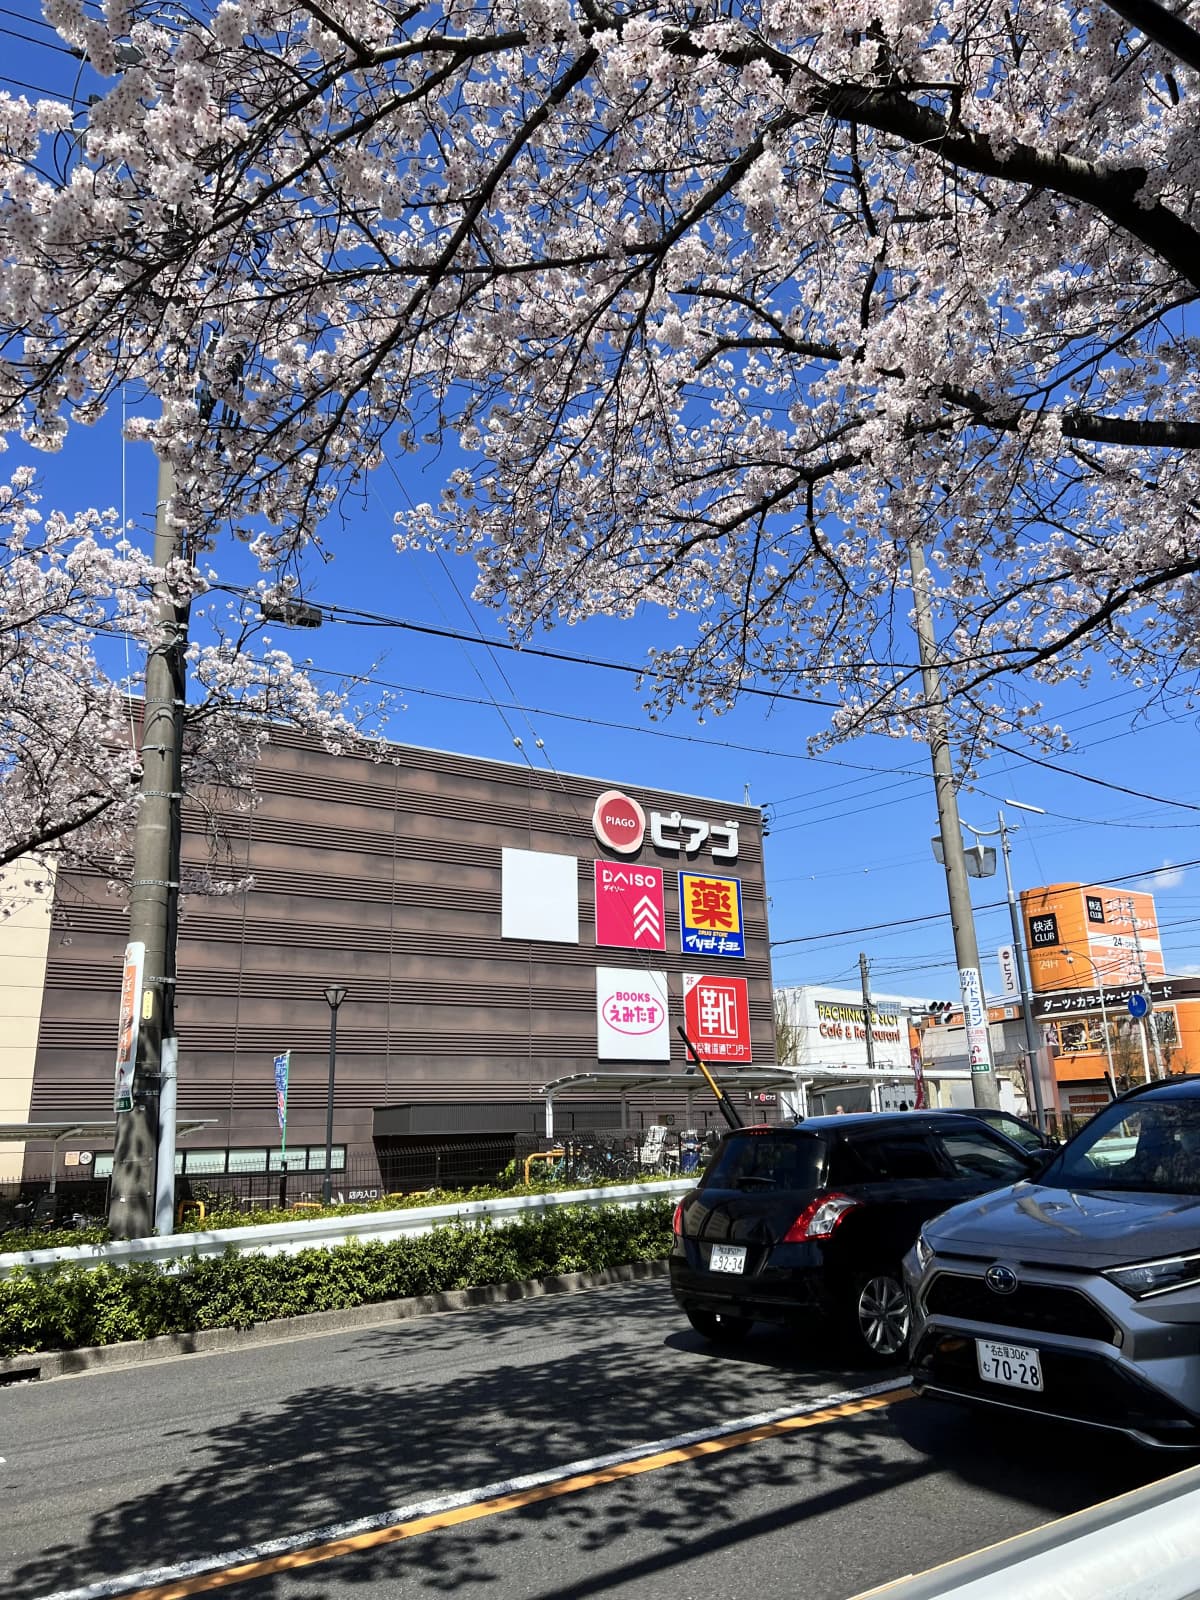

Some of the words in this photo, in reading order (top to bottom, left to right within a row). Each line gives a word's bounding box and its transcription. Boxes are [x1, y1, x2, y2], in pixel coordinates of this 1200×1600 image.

[605, 815, 636, 828] PIAGO
[650, 811, 740, 858] ピアゴ
[602, 869, 656, 888] DAISO
[690, 879, 733, 928] 薬
[1032, 919, 1055, 933] 快活
[1034, 931, 1055, 943] CLUB
[616, 991, 651, 1002] BOOKS
[700, 989, 736, 1035] 靴
[969, 986, 983, 1027] ドラゴン
[819, 1023, 844, 1039] Café
[845, 1026, 852, 1039] &
[854, 1026, 900, 1042] Reaurant
[348, 1189, 378, 1200] 店内入口
[991, 1358, 1039, 1386] 70-28
